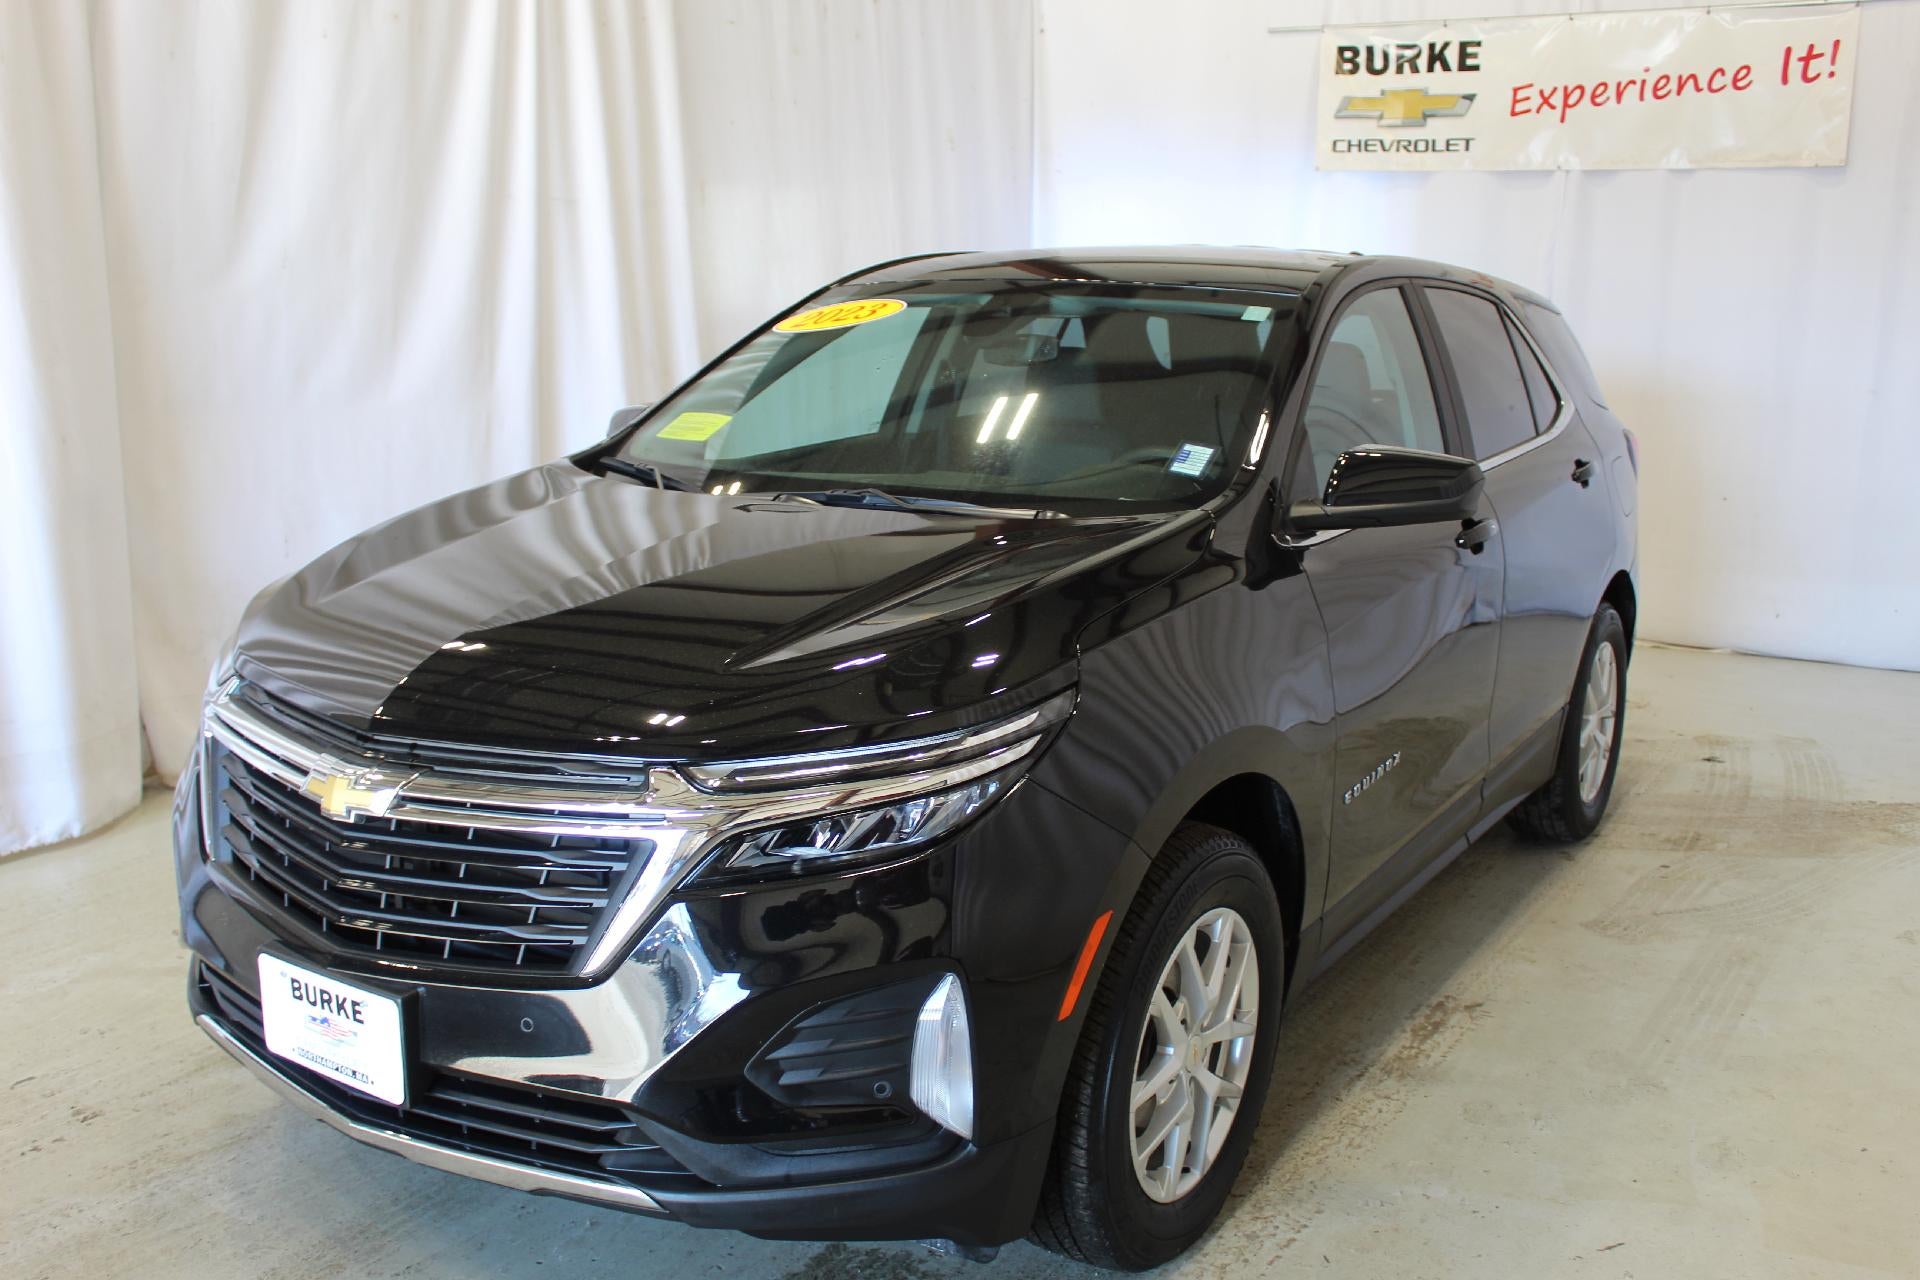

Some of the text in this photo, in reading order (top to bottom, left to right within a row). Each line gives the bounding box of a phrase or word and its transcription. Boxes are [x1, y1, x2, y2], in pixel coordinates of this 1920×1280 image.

[1335, 40, 1482, 76] BURKE
[1509, 39, 1841, 123] Experience It!
[1332, 138, 1476, 153] CHEVROLET
[791, 303, 888, 328] 2023
[1344, 751, 1401, 804] EQUINOX
[290, 977, 364, 1024] BURKE
